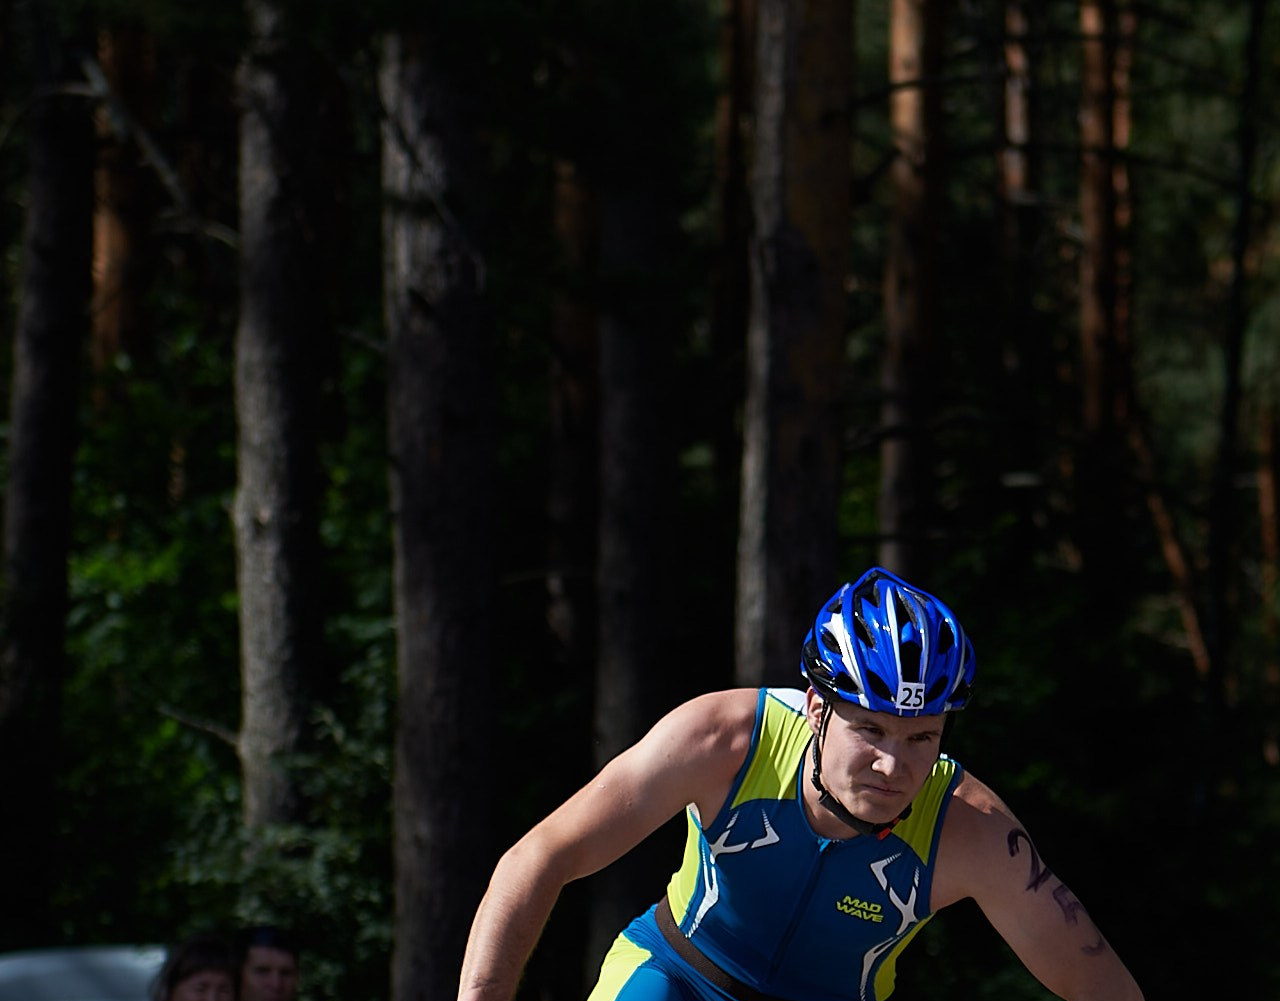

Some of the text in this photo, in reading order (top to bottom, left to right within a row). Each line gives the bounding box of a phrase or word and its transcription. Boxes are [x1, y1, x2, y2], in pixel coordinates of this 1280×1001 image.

[900, 687, 924, 708] 25
[836, 901, 884, 923] WAVE
[843, 895, 882, 913] MAD
